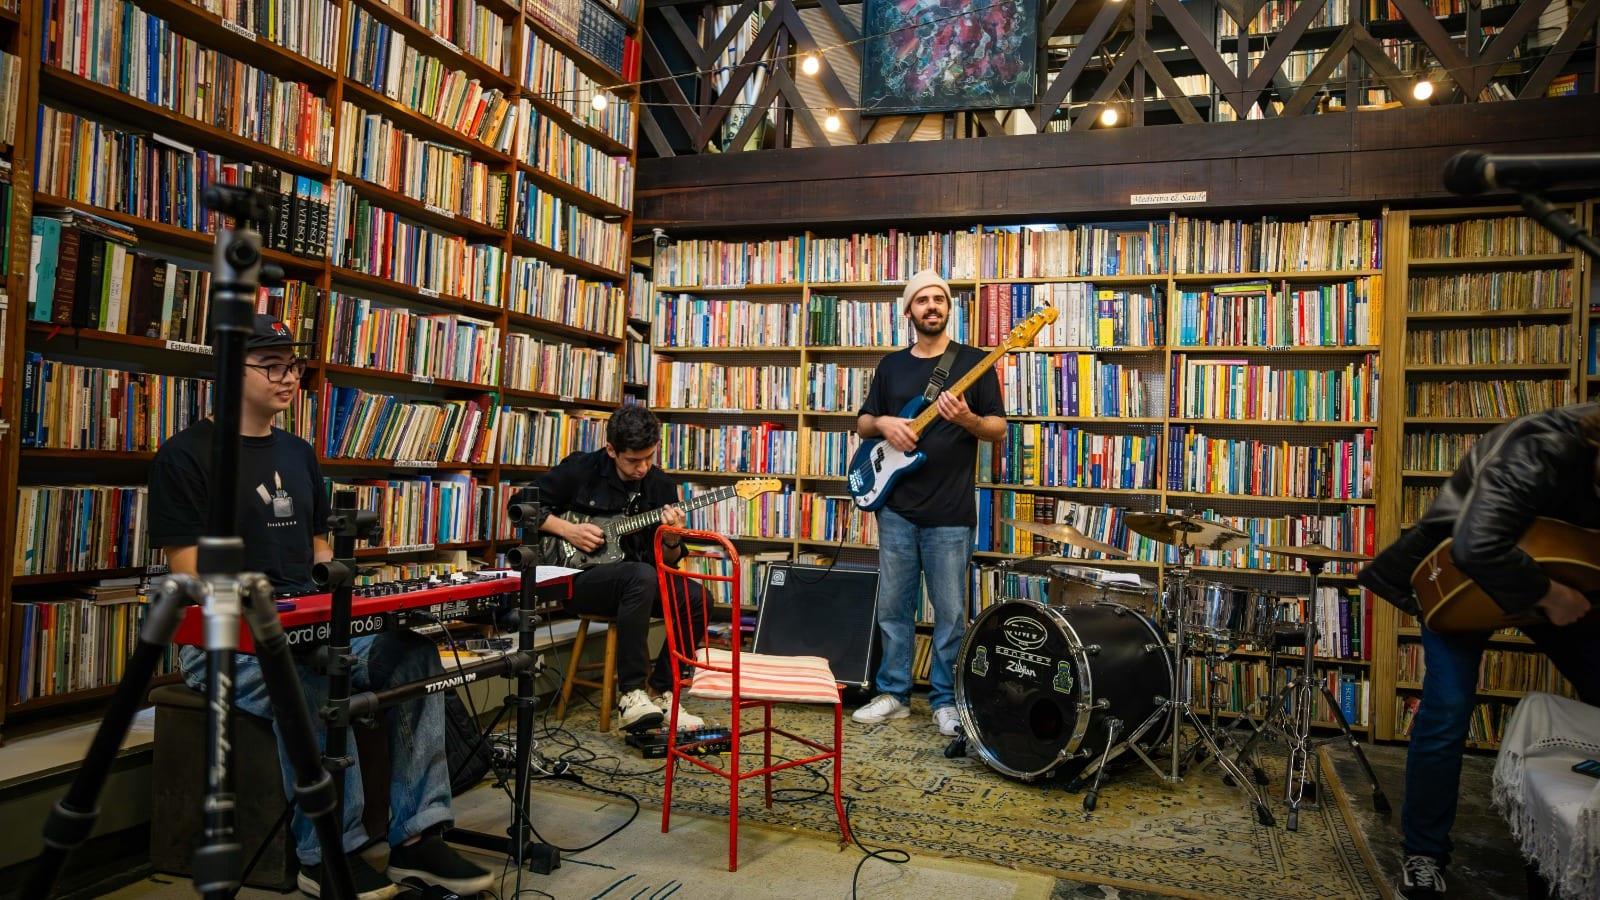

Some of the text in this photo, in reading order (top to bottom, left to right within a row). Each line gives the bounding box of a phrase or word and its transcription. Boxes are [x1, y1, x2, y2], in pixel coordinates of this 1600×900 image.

[223, 20, 255, 40] Religiosos
[1132, 194, 1168, 204] Medicina
[170, 342, 197, 353] Estudos
[1089, 345, 1123, 353] Medicina
[425, 672, 477, 693] TITANIUM
